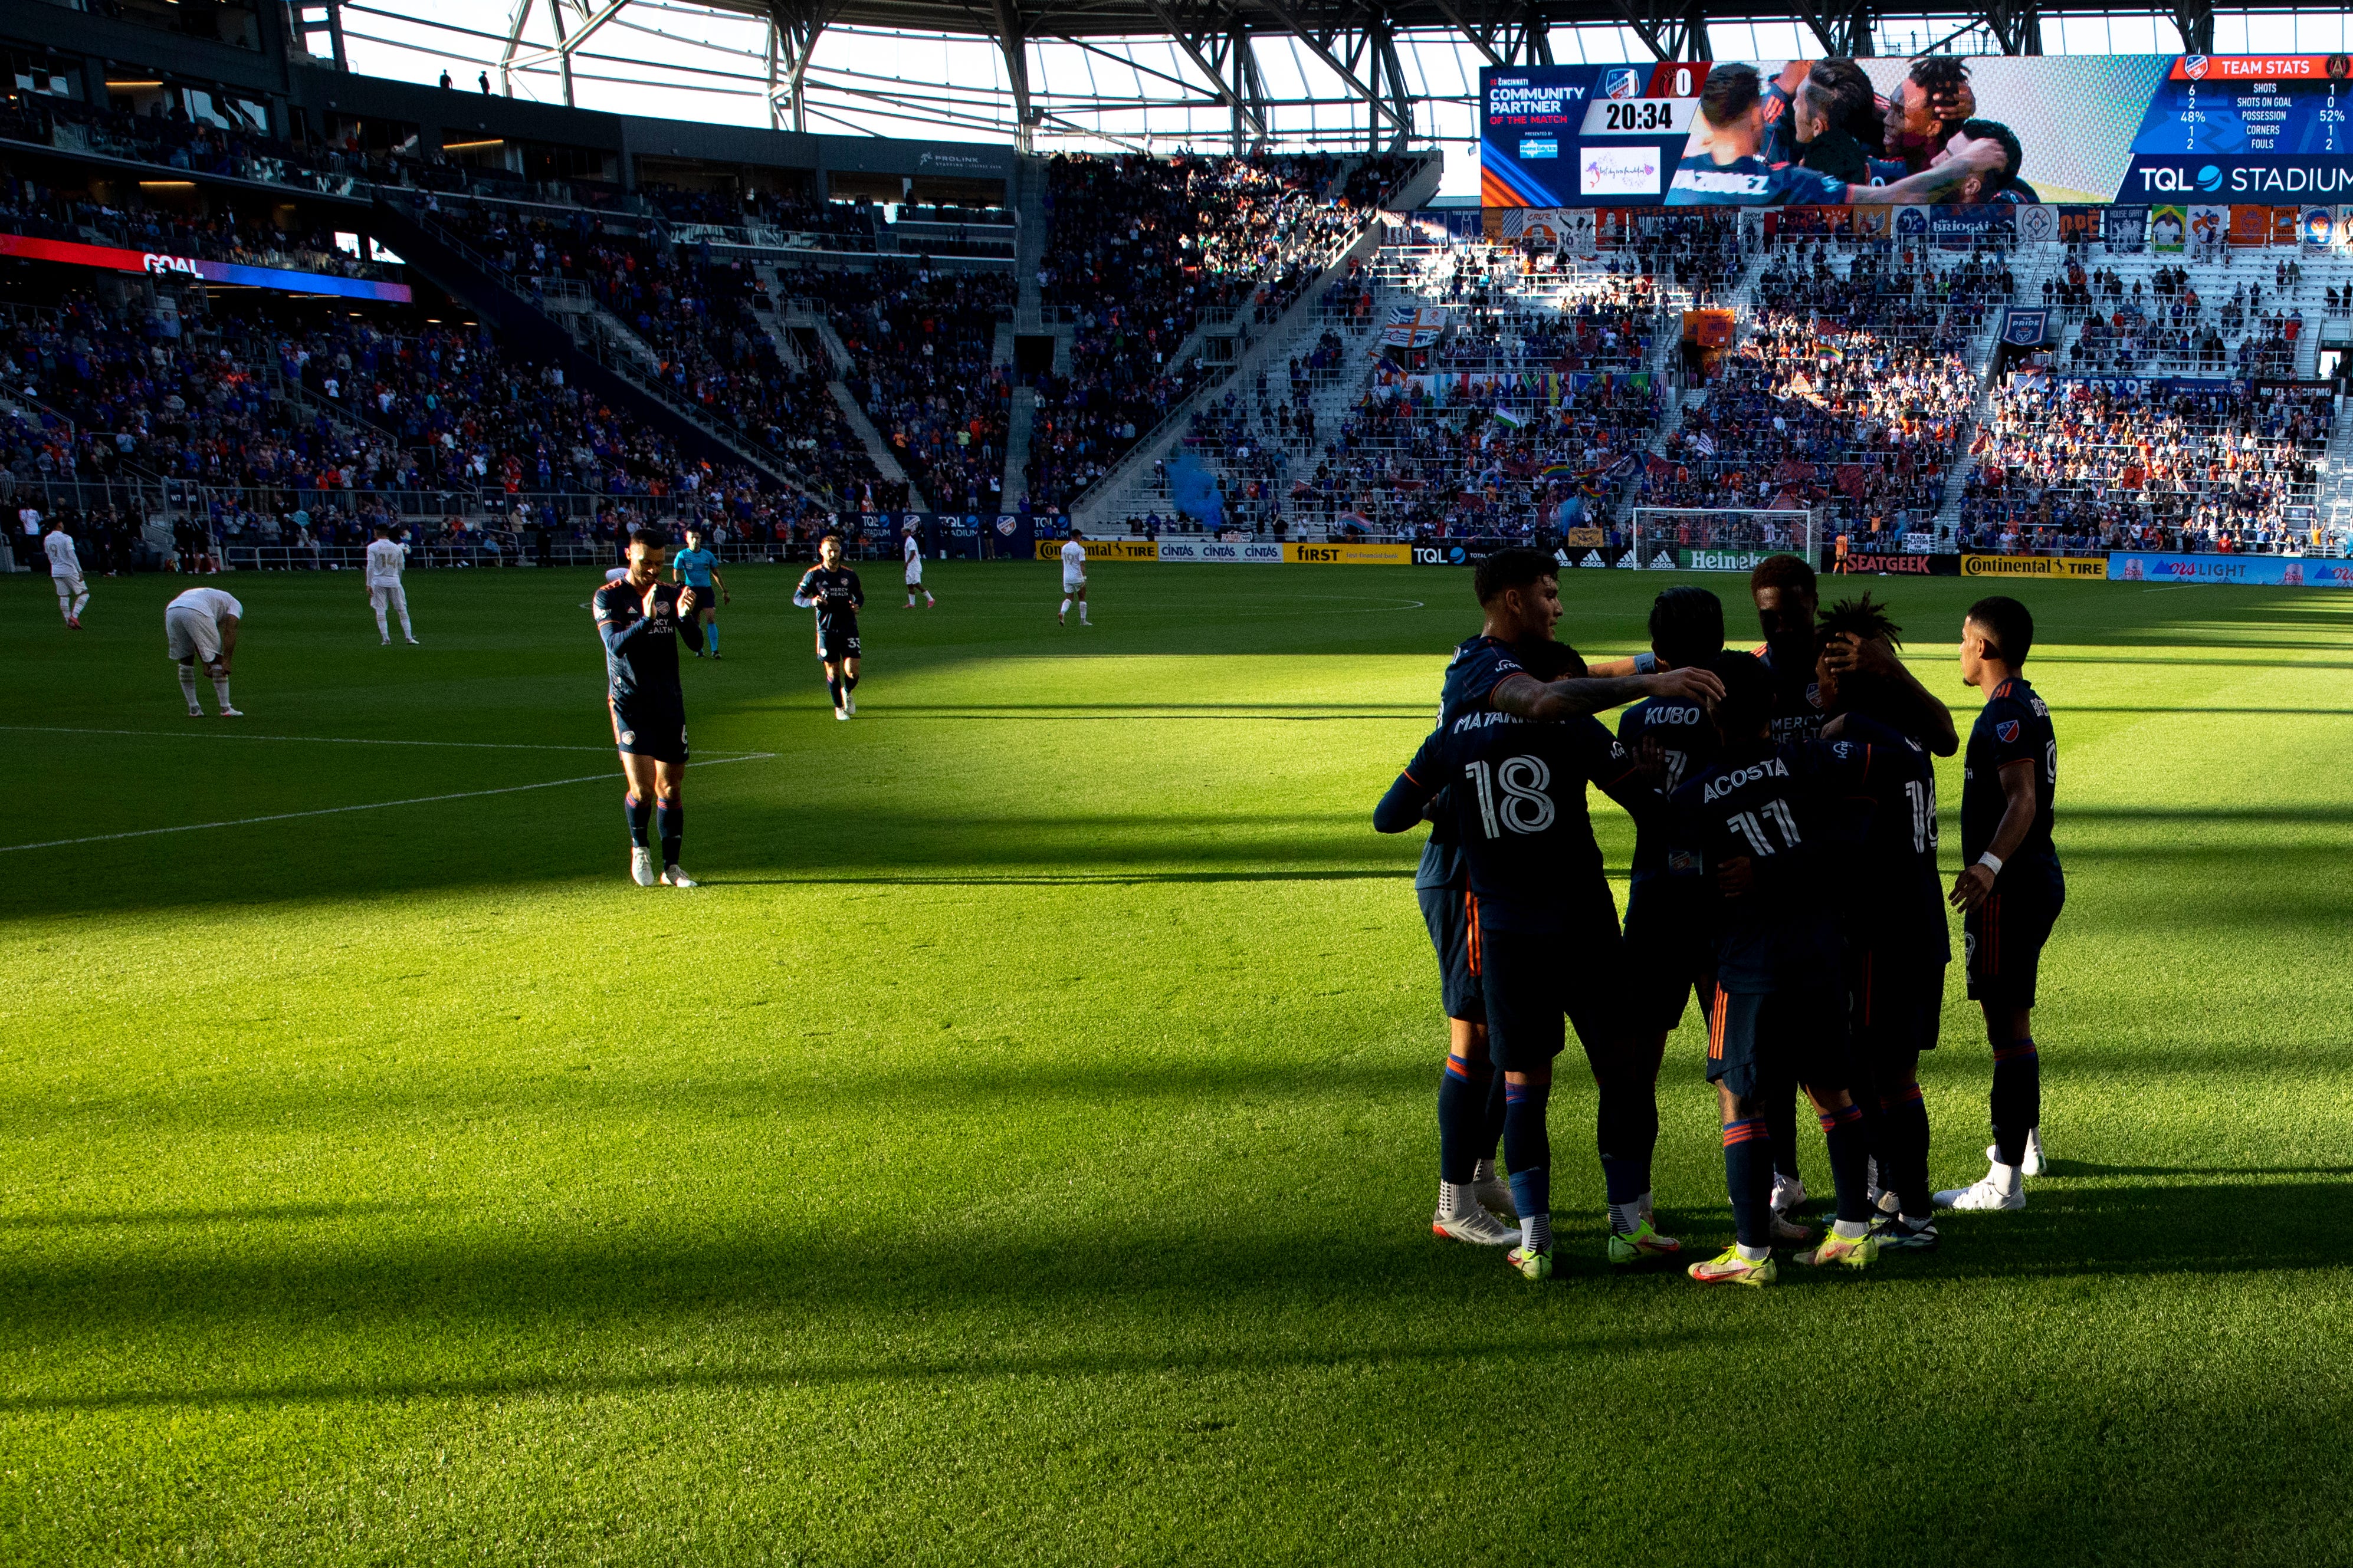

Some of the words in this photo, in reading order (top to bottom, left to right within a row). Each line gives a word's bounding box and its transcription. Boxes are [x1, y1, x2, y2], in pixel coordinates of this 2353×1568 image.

[2222, 61, 2262, 74] TEAM
[2266, 60, 2310, 74] STATS
[1625, 69, 1636, 96] 1
[1676, 68, 1691, 96] 0
[1490, 87, 1585, 101] COMMUNITY
[2188, 84, 2196, 96] 6
[2253, 83, 2277, 93] SHOTS
[2329, 84, 2335, 95] 1
[1491, 101, 1561, 114] PARTNER
[2188, 98, 2195, 109] 2
[2237, 98, 2260, 107] SHOTS
[2262, 97, 2272, 107] ON
[2274, 97, 2292, 107] GOAL
[2327, 97, 2334, 108] 0
[1607, 103, 1673, 129] 20:34
[2181, 111, 2206, 123] 48%
[2242, 111, 2286, 120] POSSESSION
[2319, 110, 2345, 121] 52%
[2189, 126, 2194, 136] 1
[2246, 125, 2280, 134] CORNERS
[2328, 125, 2333, 136] 1
[2187, 139, 2194, 149] 2
[2252, 139, 2274, 149] FOULS
[2326, 139, 2332, 150] 2
[2140, 168, 2193, 192] TQL
[2110, 210, 2127, 218] HOUSE
[143, 254, 204, 280] GOAL
[2260, 387, 2273, 396] NO
[862, 515, 879, 527] TQL
[863, 528, 891, 537] STADIUM
[1033, 530, 1069, 538] STUM
[1125, 546, 1155, 557] TIRE
[1413, 548, 1448, 564] TQL
[379, 553, 397, 568] 14
[1847, 554, 1931, 574] SEATGEEK
[1965, 556, 2051, 575] Continental
[2069, 563, 2102, 574] TIRE
[2199, 563, 2247, 577] LIGHT
[1645, 706, 1700, 726] KUBO
[1704, 756, 1790, 804] ACOSTA
[1465, 754, 1555, 840] 18
[1726, 798, 1802, 857] 11
